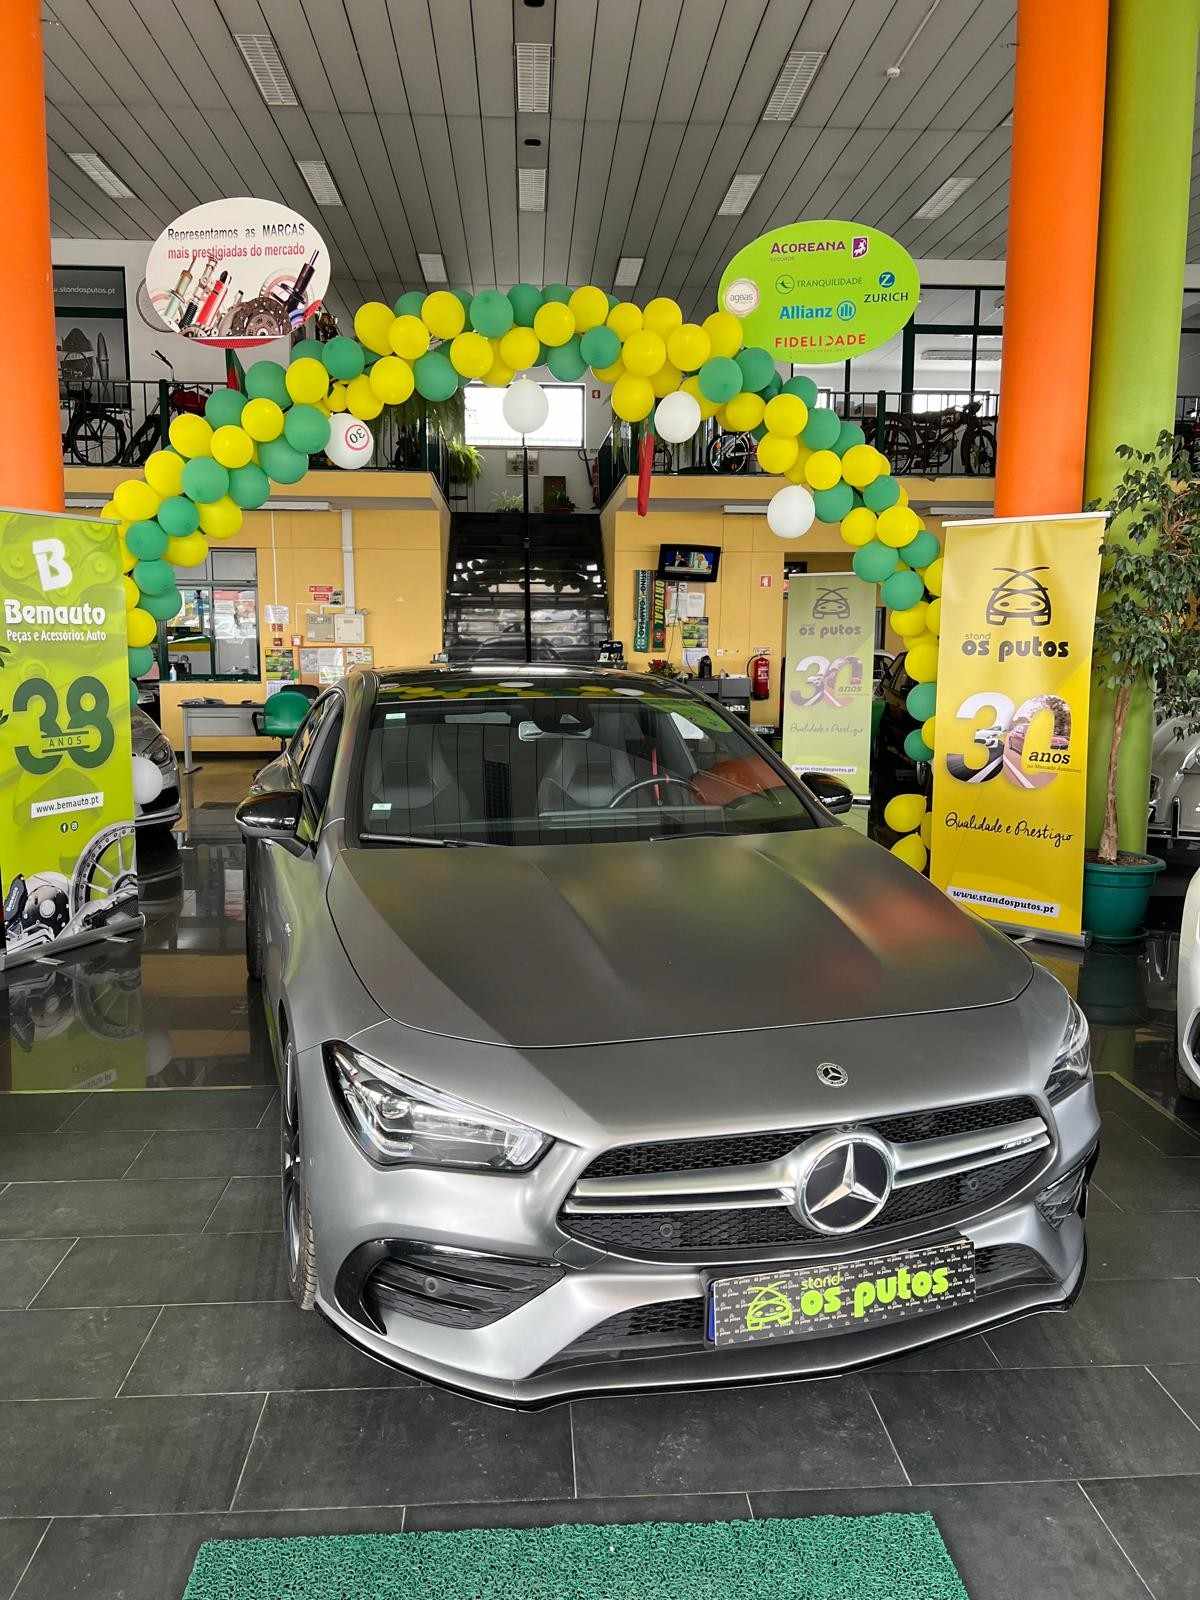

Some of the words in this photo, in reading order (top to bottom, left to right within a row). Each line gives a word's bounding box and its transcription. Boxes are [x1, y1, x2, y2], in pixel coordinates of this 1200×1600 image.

[167, 228, 239, 242] Representamos
[244, 229, 256, 238] as
[262, 223, 305, 237] MARCAS
[167, 247, 190, 259] mais
[191, 244, 248, 261] prestigiadas
[250, 243, 262, 256] do
[264, 243, 305, 256] mercado
[797, 276, 863, 288] TRANQUILIDADE
[729, 293, 754, 302] ageas
[863, 292, 909, 303] ZURICH
[779, 305, 833, 320] Allianz
[774, 333, 866, 348] FIDELIDADE
[32, 538, 73, 592] B
[4, 599, 106, 625] Bemauto
[6, 629, 32, 643] Peças
[33, 631, 40, 641] e
[41, 628, 85, 641] Acessórios
[86, 629, 107, 641] Auto
[799, 626, 816, 636] os
[820, 624, 862, 639] putos
[961, 639, 990, 656] os
[998, 636, 1069, 662] putos
[789, 655, 864, 707] 30
[13, 675, 115, 775] 38
[50, 737, 82, 748] ANOS
[946, 692, 1072, 789] 30
[1028, 750, 1071, 765] anos
[36, 795, 99, 814] www.bemauto.pt
[945, 811, 1003, 834] Qualidade
[1005, 825, 1014, 834] e
[952, 889, 1055, 914] www.standosputos.pt
[800, 1272, 844, 1289] stand
[800, 1286, 842, 1316] os
[853, 1266, 949, 1318] putos
